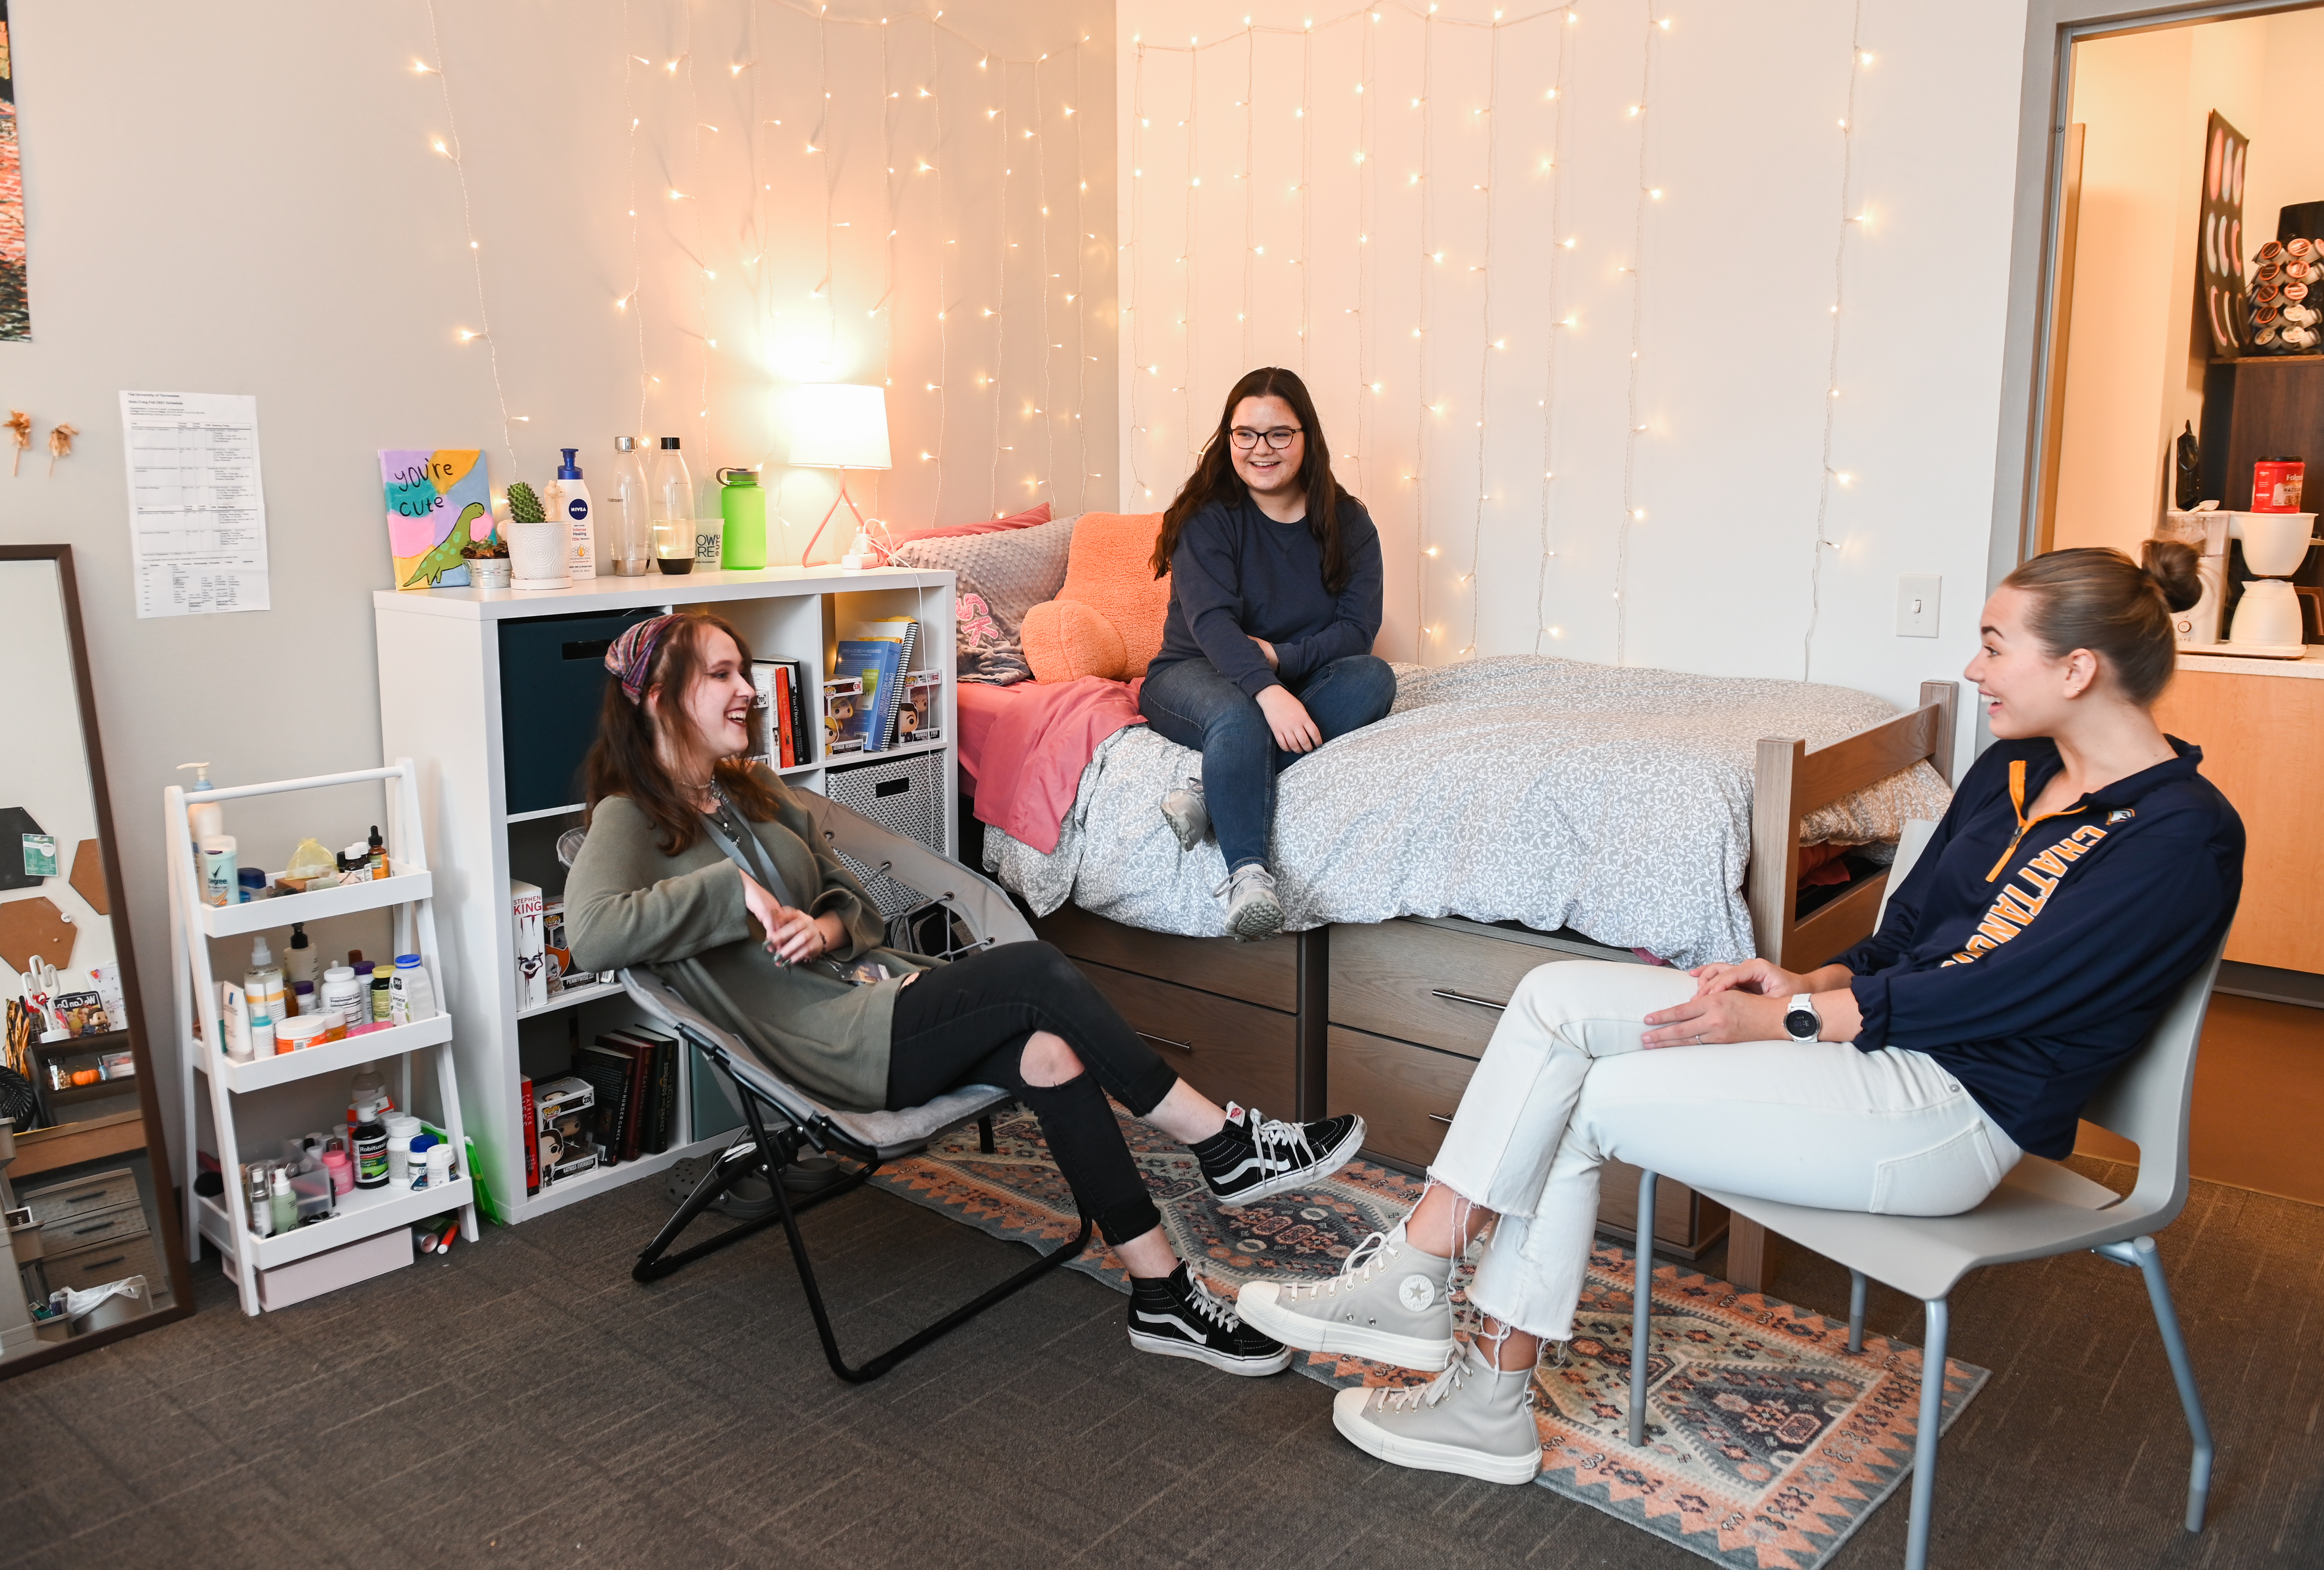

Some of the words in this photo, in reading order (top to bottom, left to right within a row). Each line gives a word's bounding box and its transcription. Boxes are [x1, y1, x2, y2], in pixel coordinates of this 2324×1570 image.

[394, 458, 453, 492] you're
[399, 497, 444, 517] cute
[695, 534, 716, 546] OW
[695, 546, 715, 557] RE
[887, 672, 895, 691] EMPIRES
[882, 698, 890, 718] COLONIES
[513, 895, 541, 905] STEPHEN
[514, 901, 542, 916] KING
[520, 913, 542, 939] IT
[544, 916, 560, 926] POP!
[566, 974, 589, 985] PENNYWISE
[639, 1075, 648, 1110] CATCHING
[543, 1105, 560, 1117] POP!
[563, 1166, 577, 1174] KATNISS
[577, 1159, 594, 1169] EVERDEEN
[1405, 1278, 1431, 1291] CONVERSE
